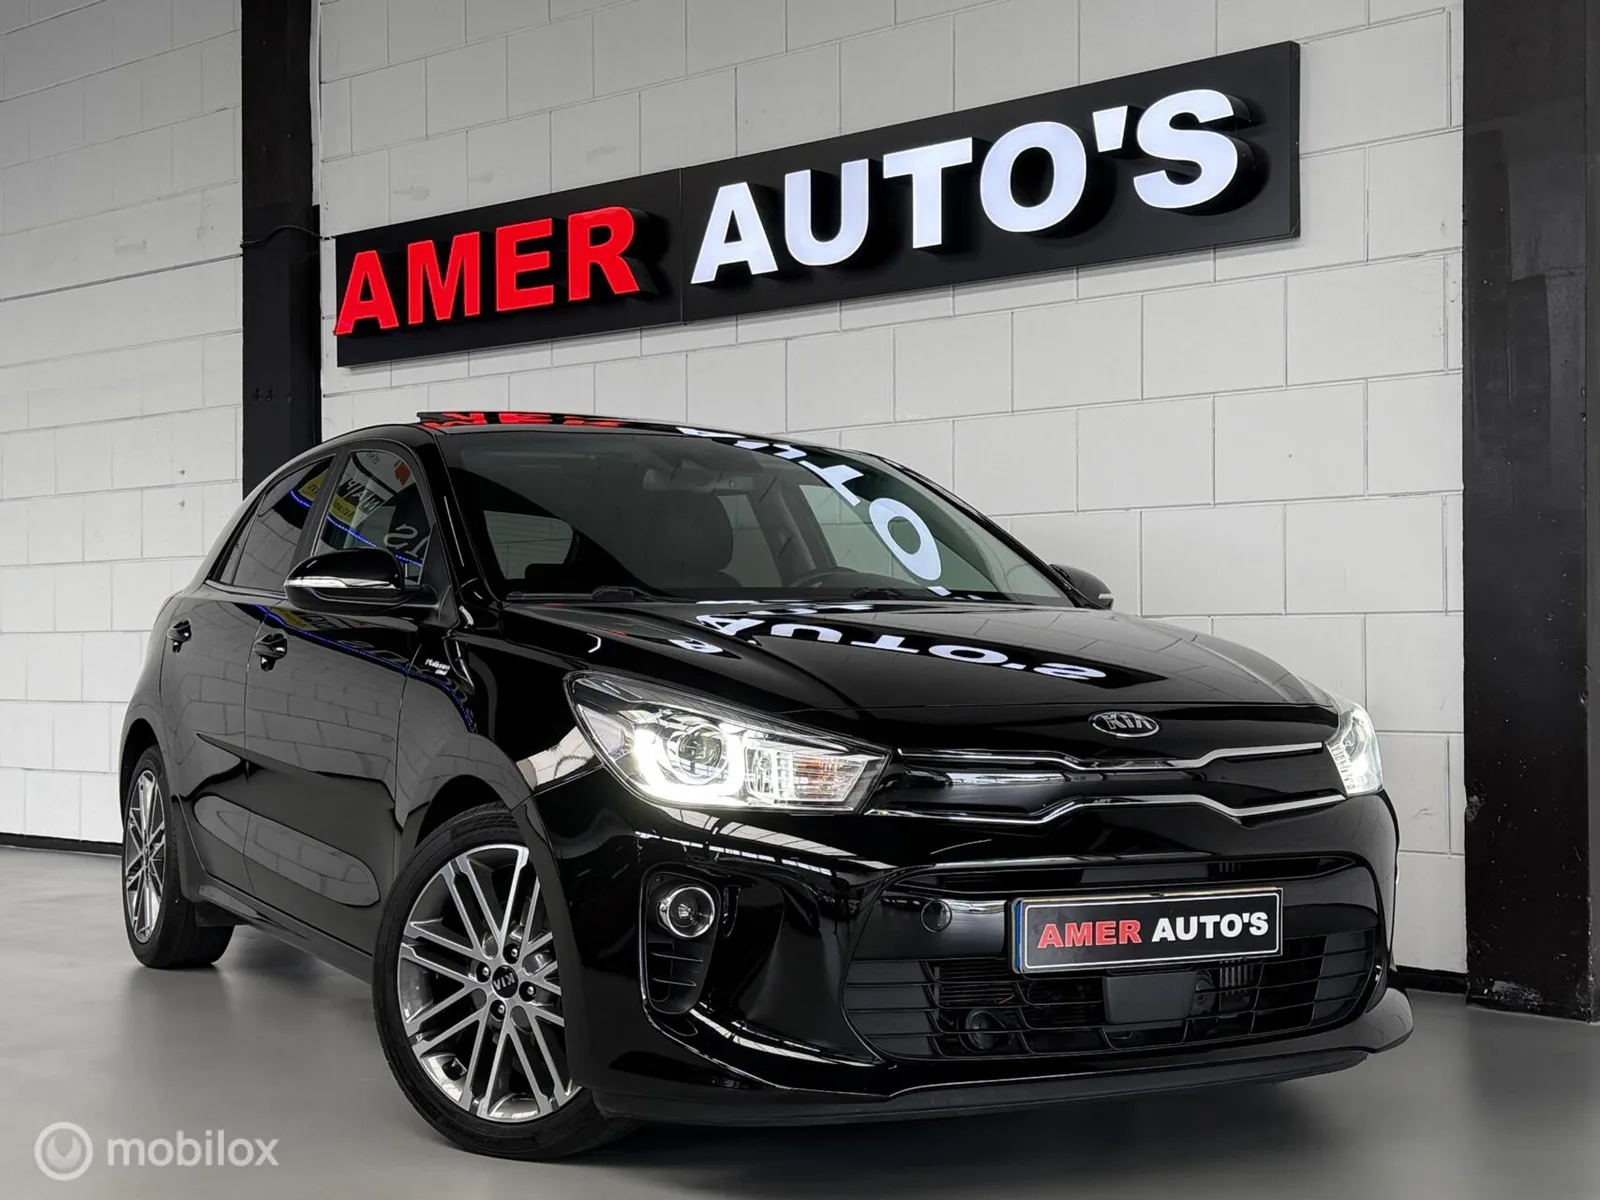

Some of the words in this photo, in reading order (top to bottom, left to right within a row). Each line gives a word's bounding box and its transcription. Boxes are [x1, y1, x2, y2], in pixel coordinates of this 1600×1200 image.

[333, 206, 640, 336] AMER
[691, 89, 1238, 284] AUTO'S
[1104, 713, 1152, 730] KIA
[1037, 920, 1142, 948] AMER
[1152, 912, 1269, 942] AUTO'S
[493, 972, 516, 991] KIA
